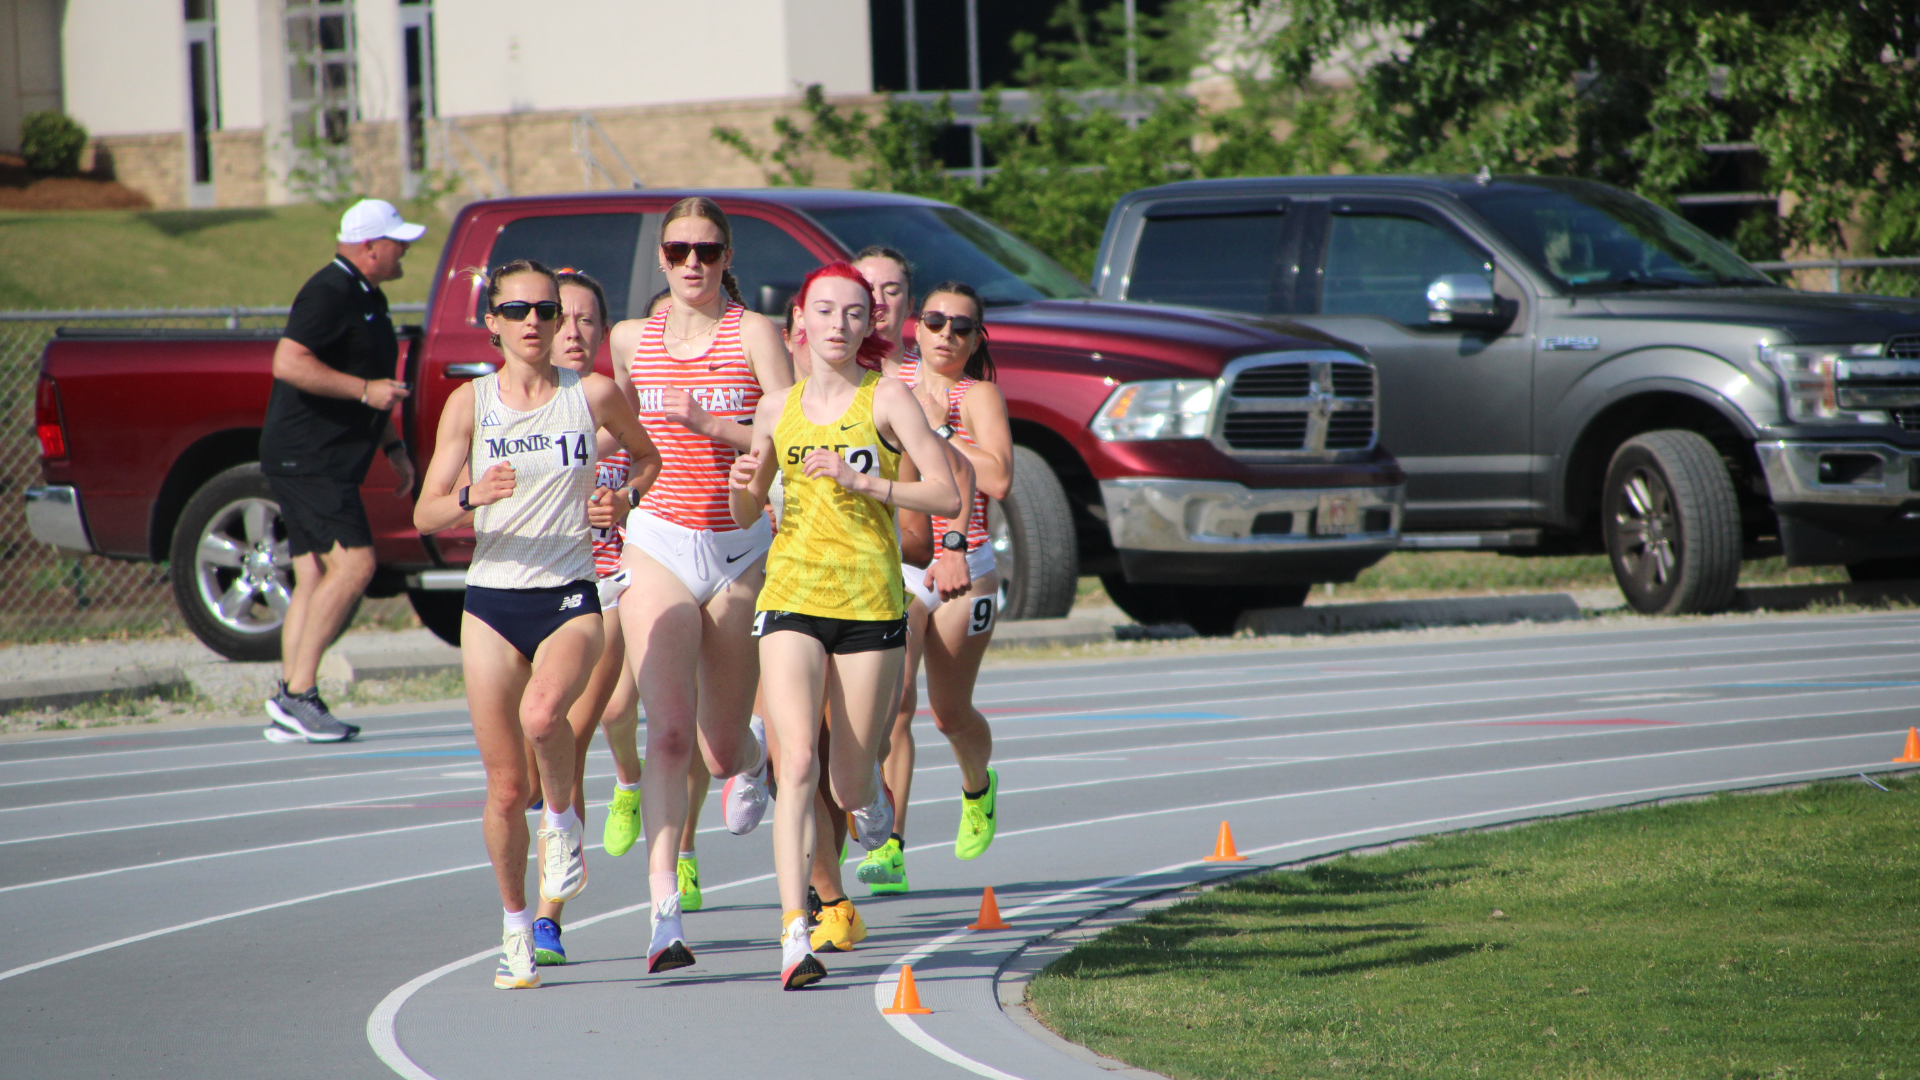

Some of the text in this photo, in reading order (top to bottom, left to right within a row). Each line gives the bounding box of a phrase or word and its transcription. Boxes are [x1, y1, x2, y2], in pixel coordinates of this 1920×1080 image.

[638, 387, 745, 412] MIGAN
[555, 434, 588, 466] 14
[973, 598, 992, 632] 9
